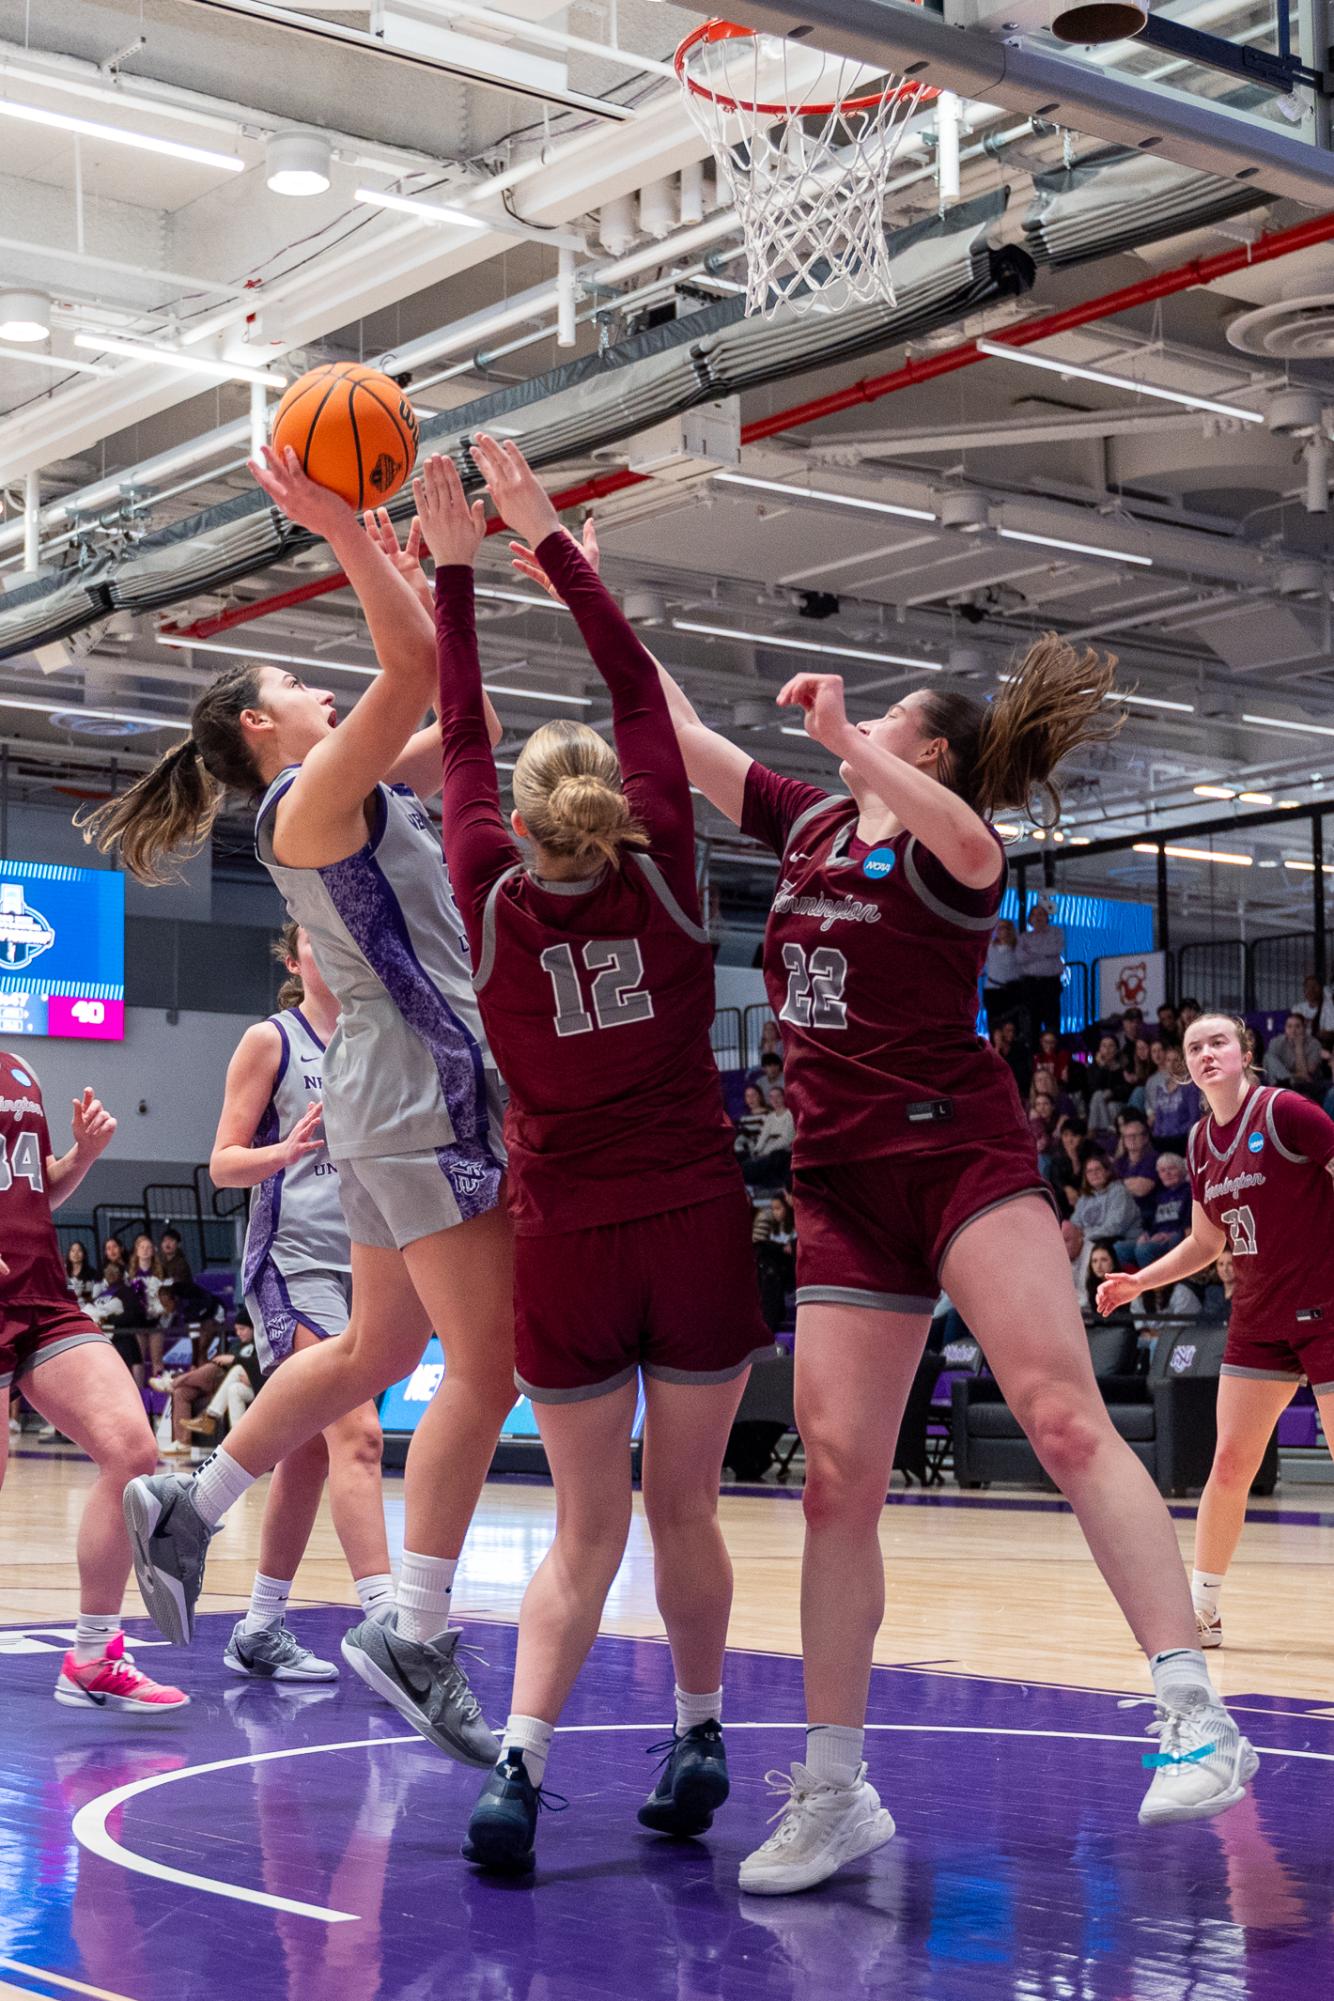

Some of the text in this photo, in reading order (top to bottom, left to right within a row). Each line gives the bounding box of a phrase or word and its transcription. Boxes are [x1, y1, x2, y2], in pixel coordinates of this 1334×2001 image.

[865, 861, 891, 873] NCAA
[71, 1000, 105, 1024] 40
[539, 937, 655, 1038] 12
[778, 942, 848, 1030] 22
[1220, 1204, 1258, 1257] 21
